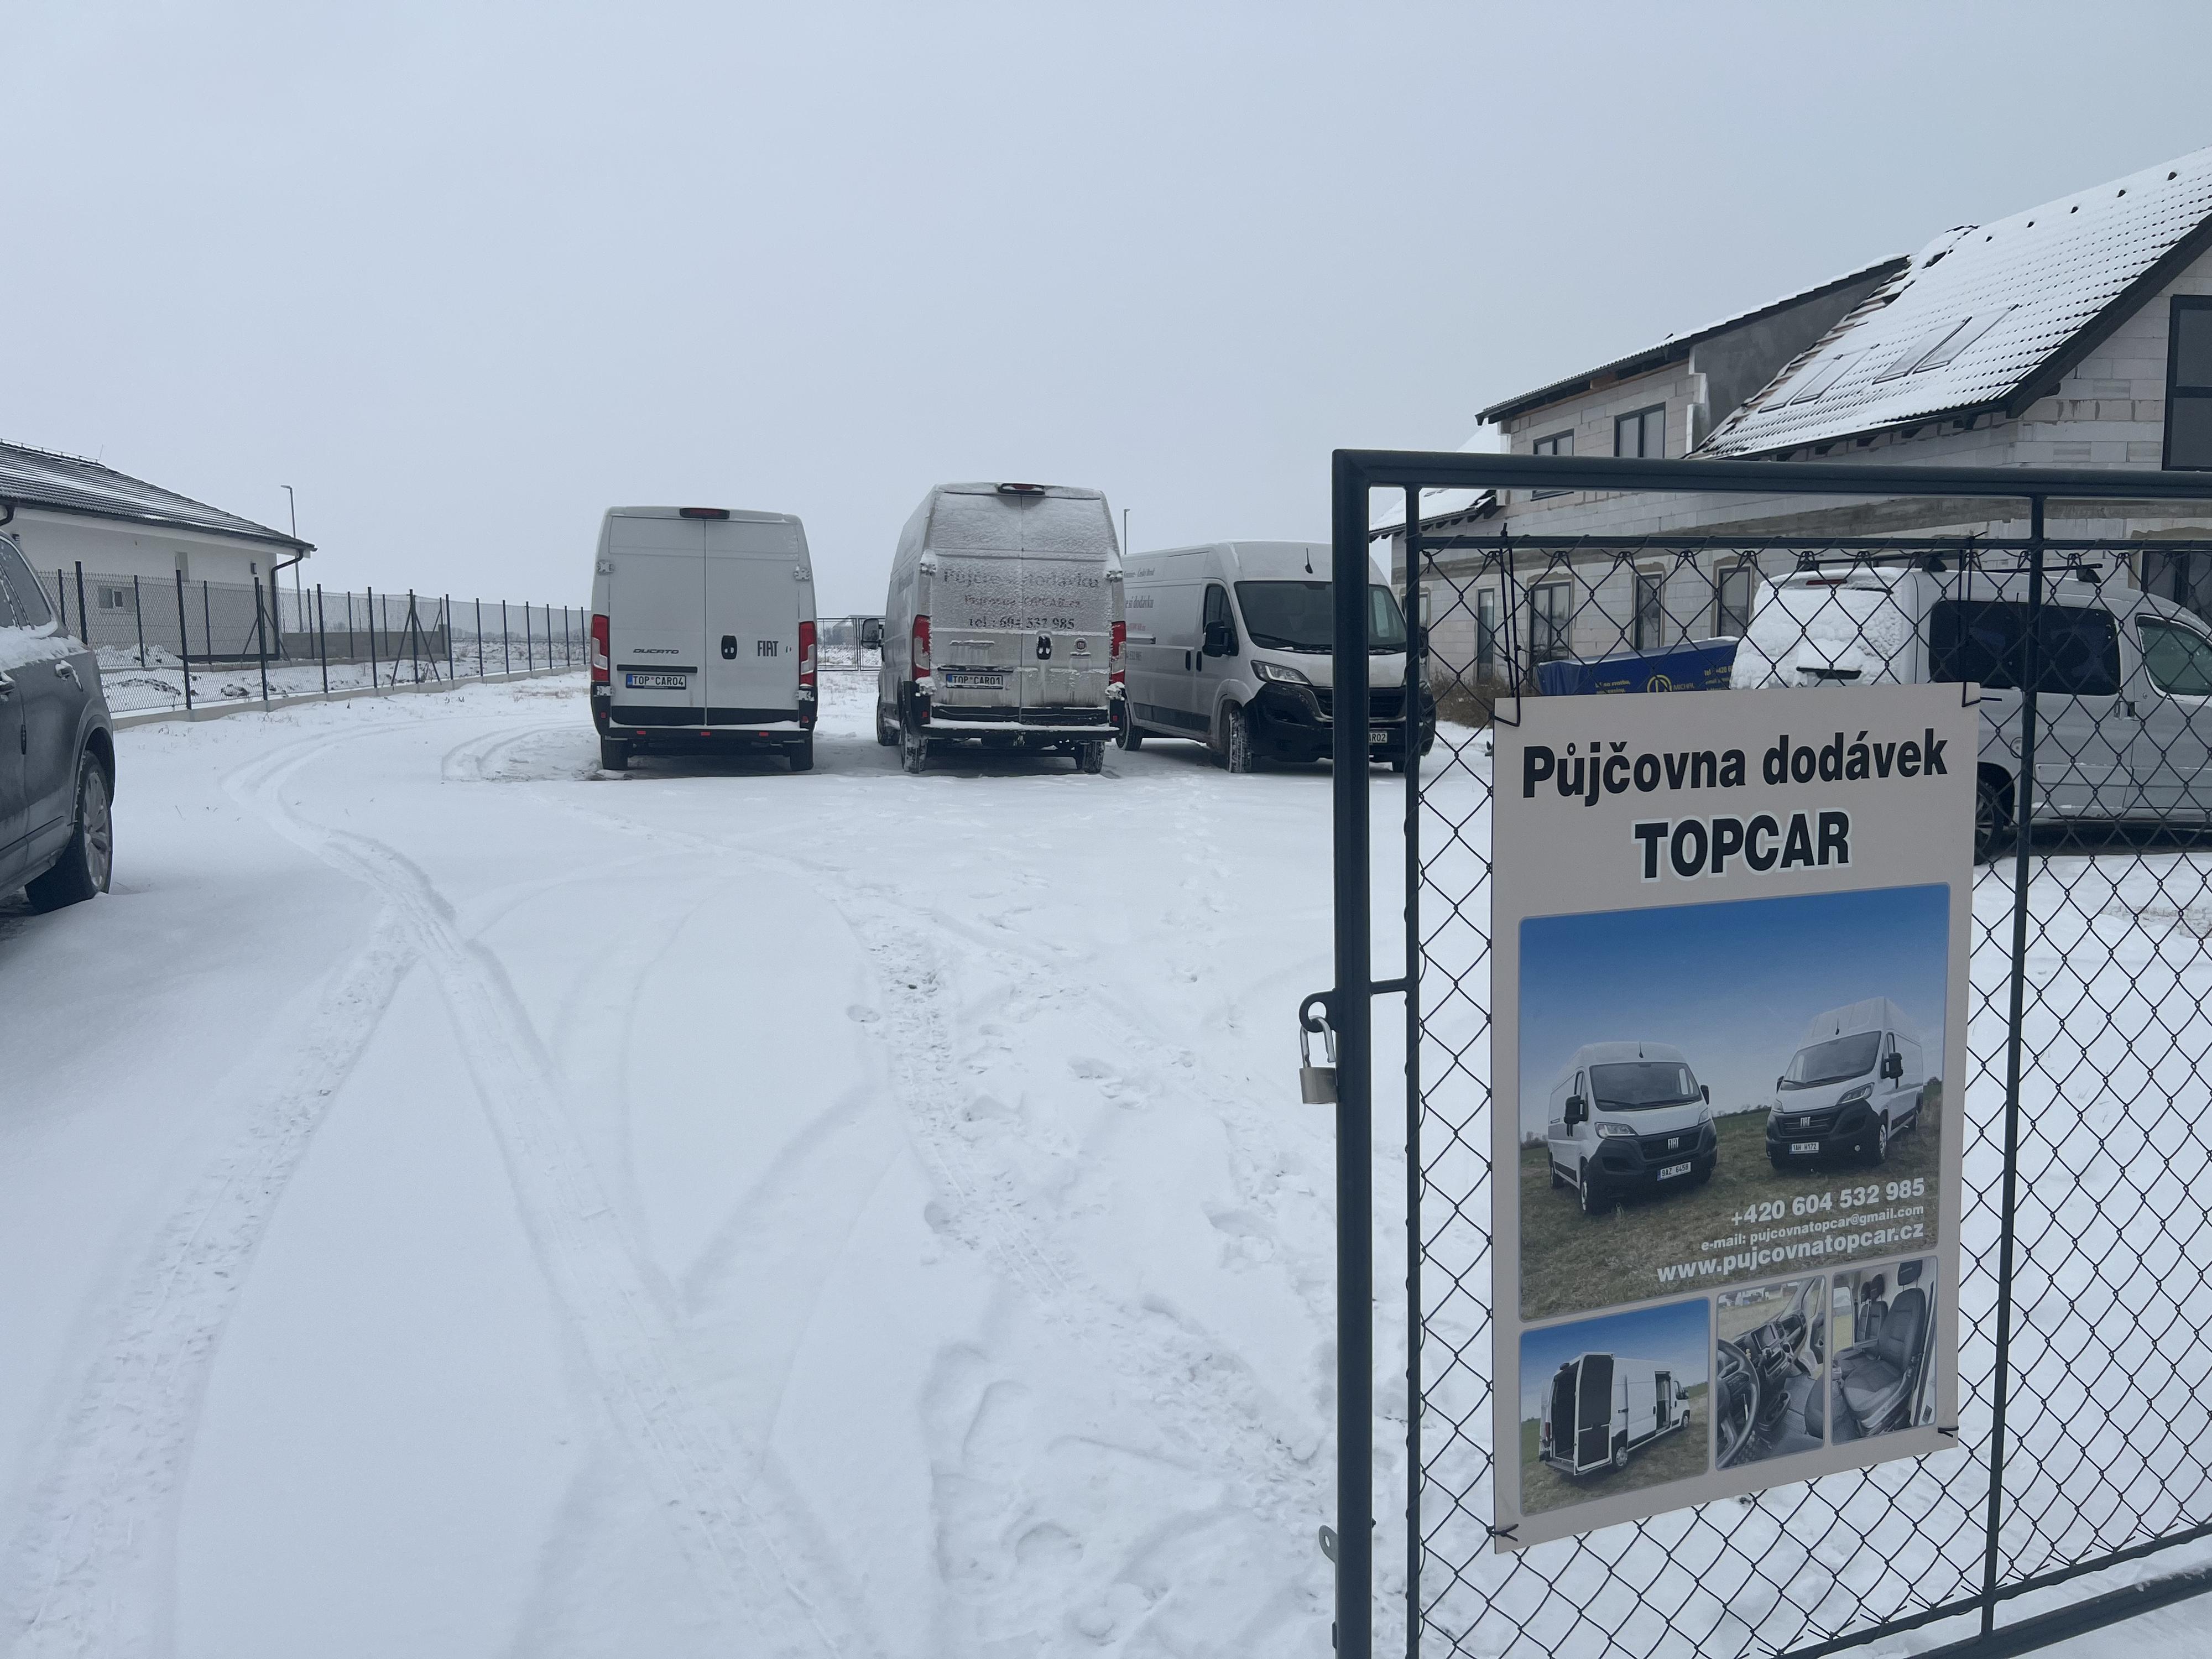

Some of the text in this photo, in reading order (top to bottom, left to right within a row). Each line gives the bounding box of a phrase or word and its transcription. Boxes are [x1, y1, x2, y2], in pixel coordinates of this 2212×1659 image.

[1052, 617, 1075, 630] 985
[757, 640, 779, 657] FIAT
[633, 676, 650, 685] TOP
[1522, 728, 1948, 807] Půjčovna dodávek
[1634, 810, 1851, 880] TOPCAR
[1668, 1137, 1679, 1150] FIAT
[1731, 1177, 1925, 1226] +420 604 532 985
[1701, 1203, 1924, 1251] e-mail: pujcovnatopcar@gmail.com
[1657, 1222, 1924, 1283] www.pujcovnatopcar.cz
